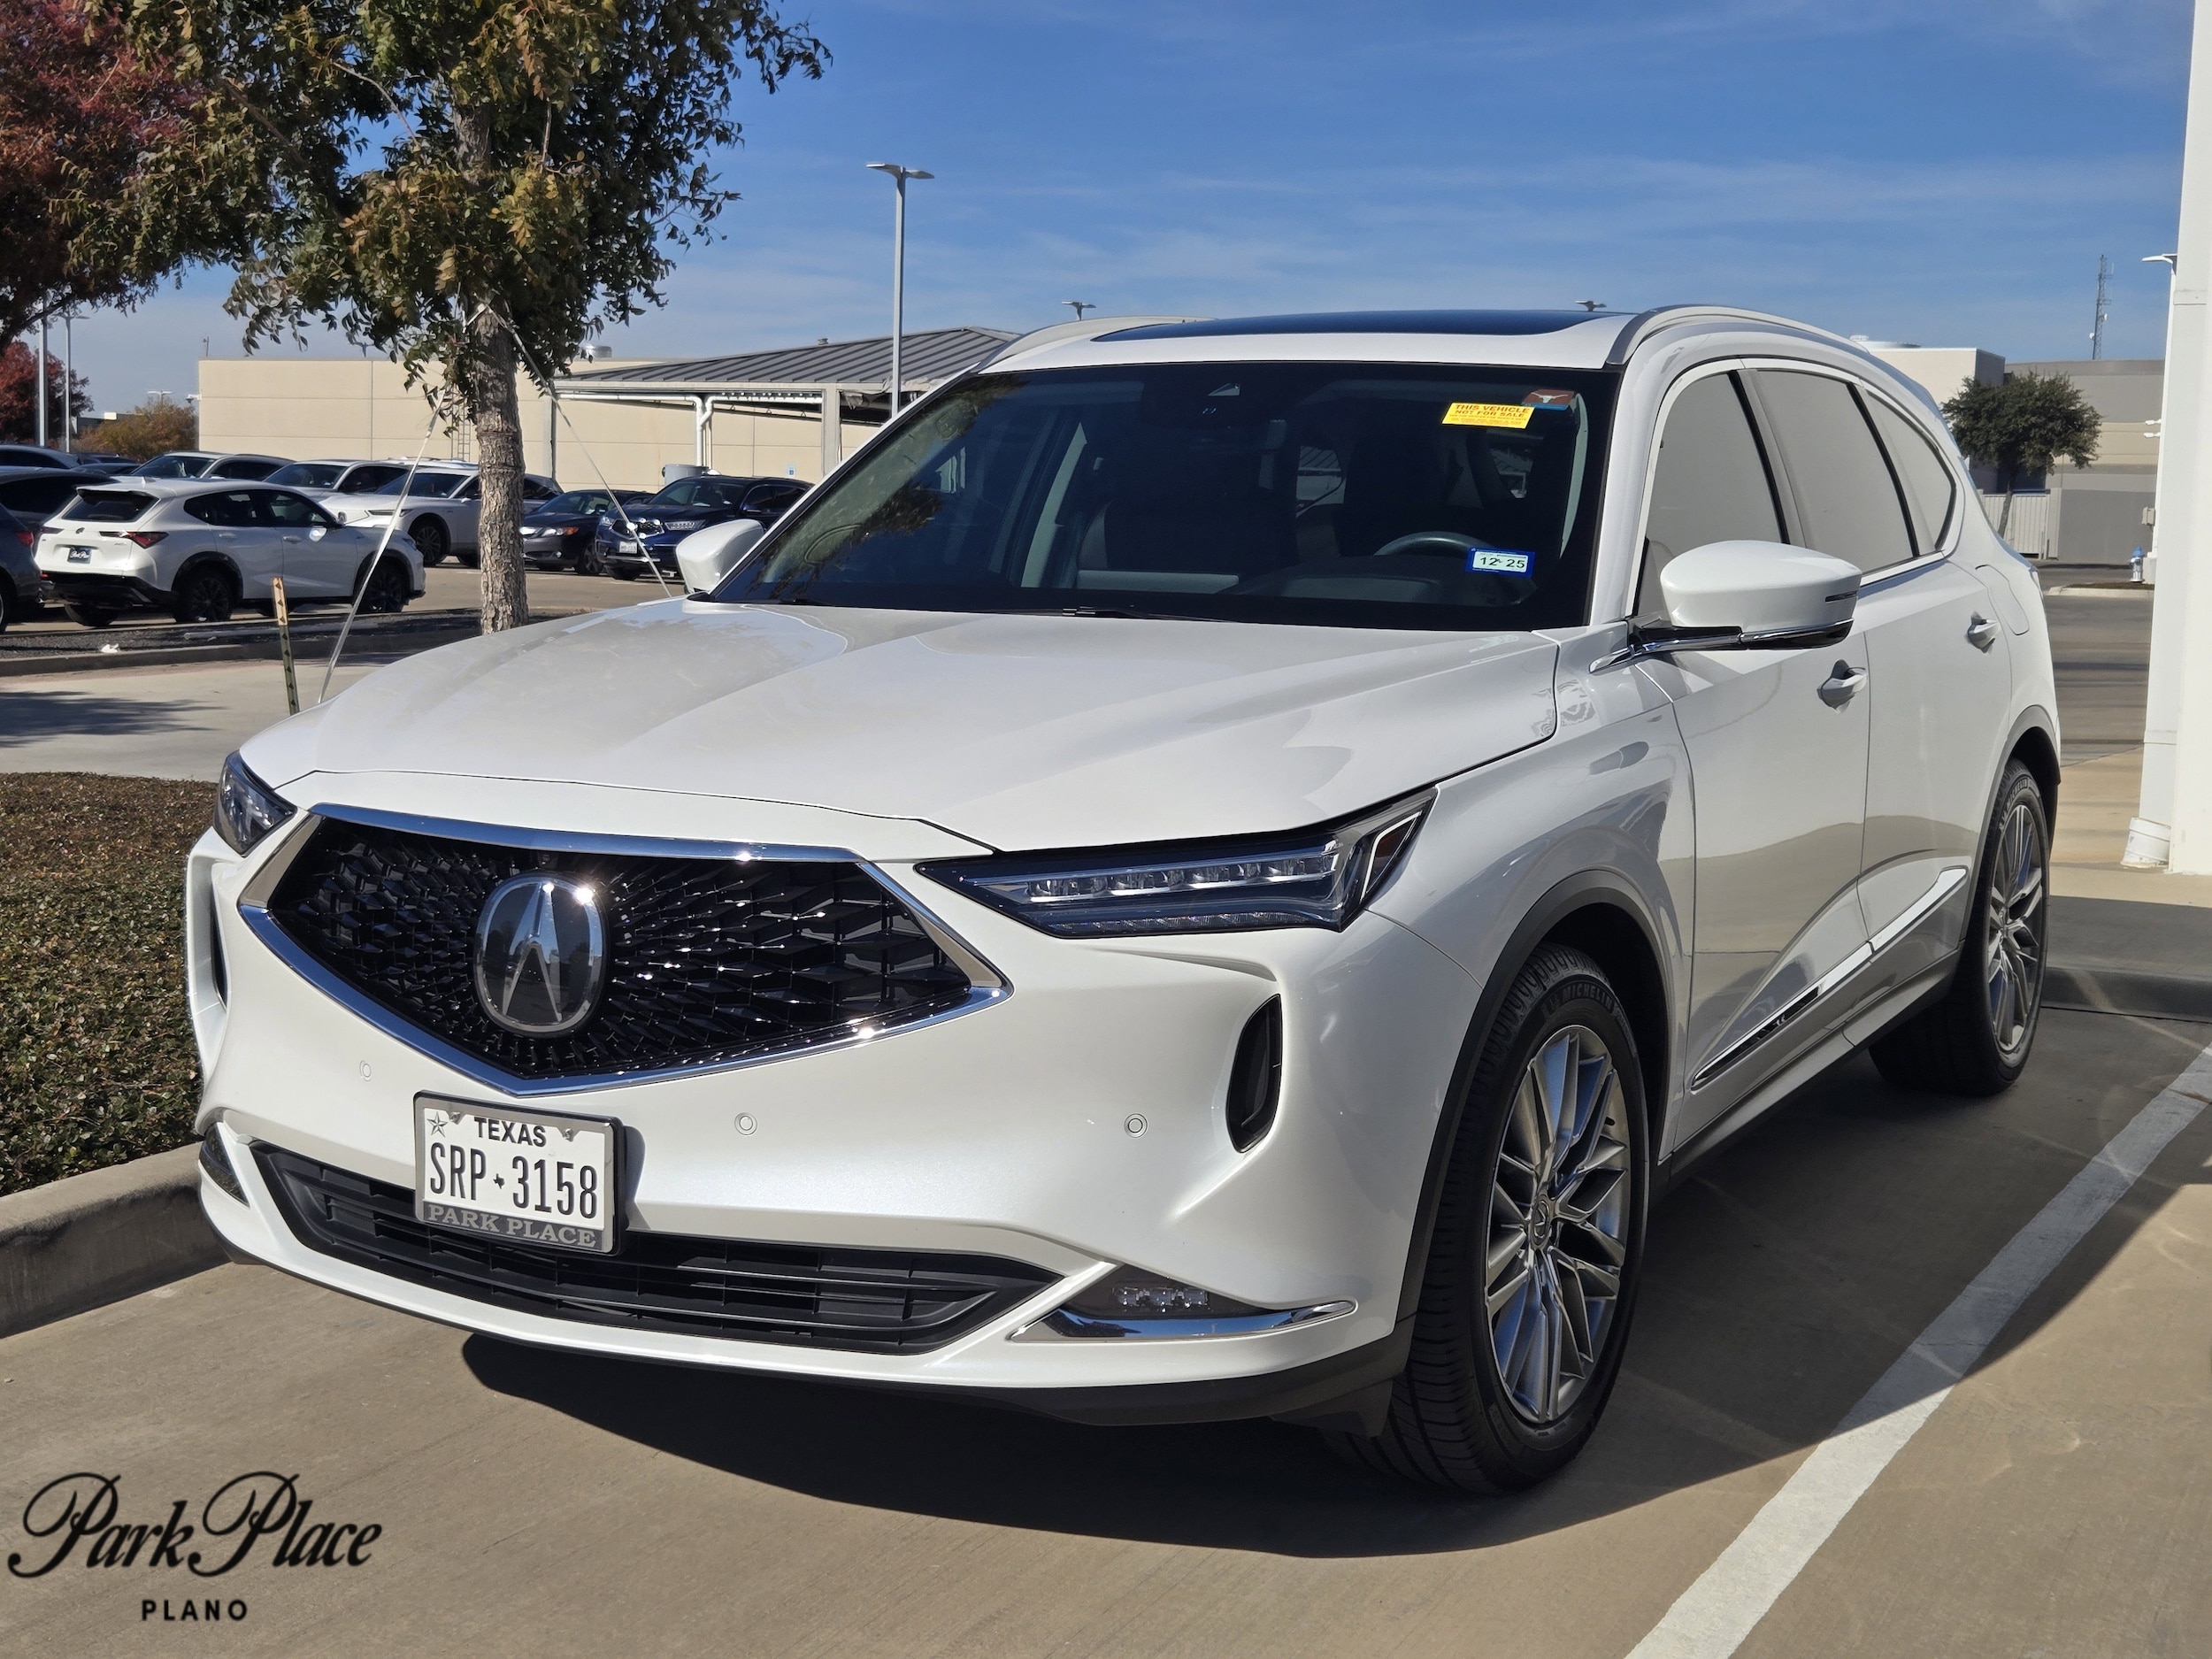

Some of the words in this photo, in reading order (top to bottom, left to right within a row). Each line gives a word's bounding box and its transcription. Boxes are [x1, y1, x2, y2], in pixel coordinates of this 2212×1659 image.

[1506, 558, 1525, 568] 25
[1563, 983, 1613, 1011] MICHELIN
[473, 1117, 547, 1148] TEXAS
[430, 1141, 487, 1202] SRP
[511, 1156, 597, 1219] 3158
[428, 1204, 501, 1233] PARK
[506, 1217, 596, 1248] PLACE
